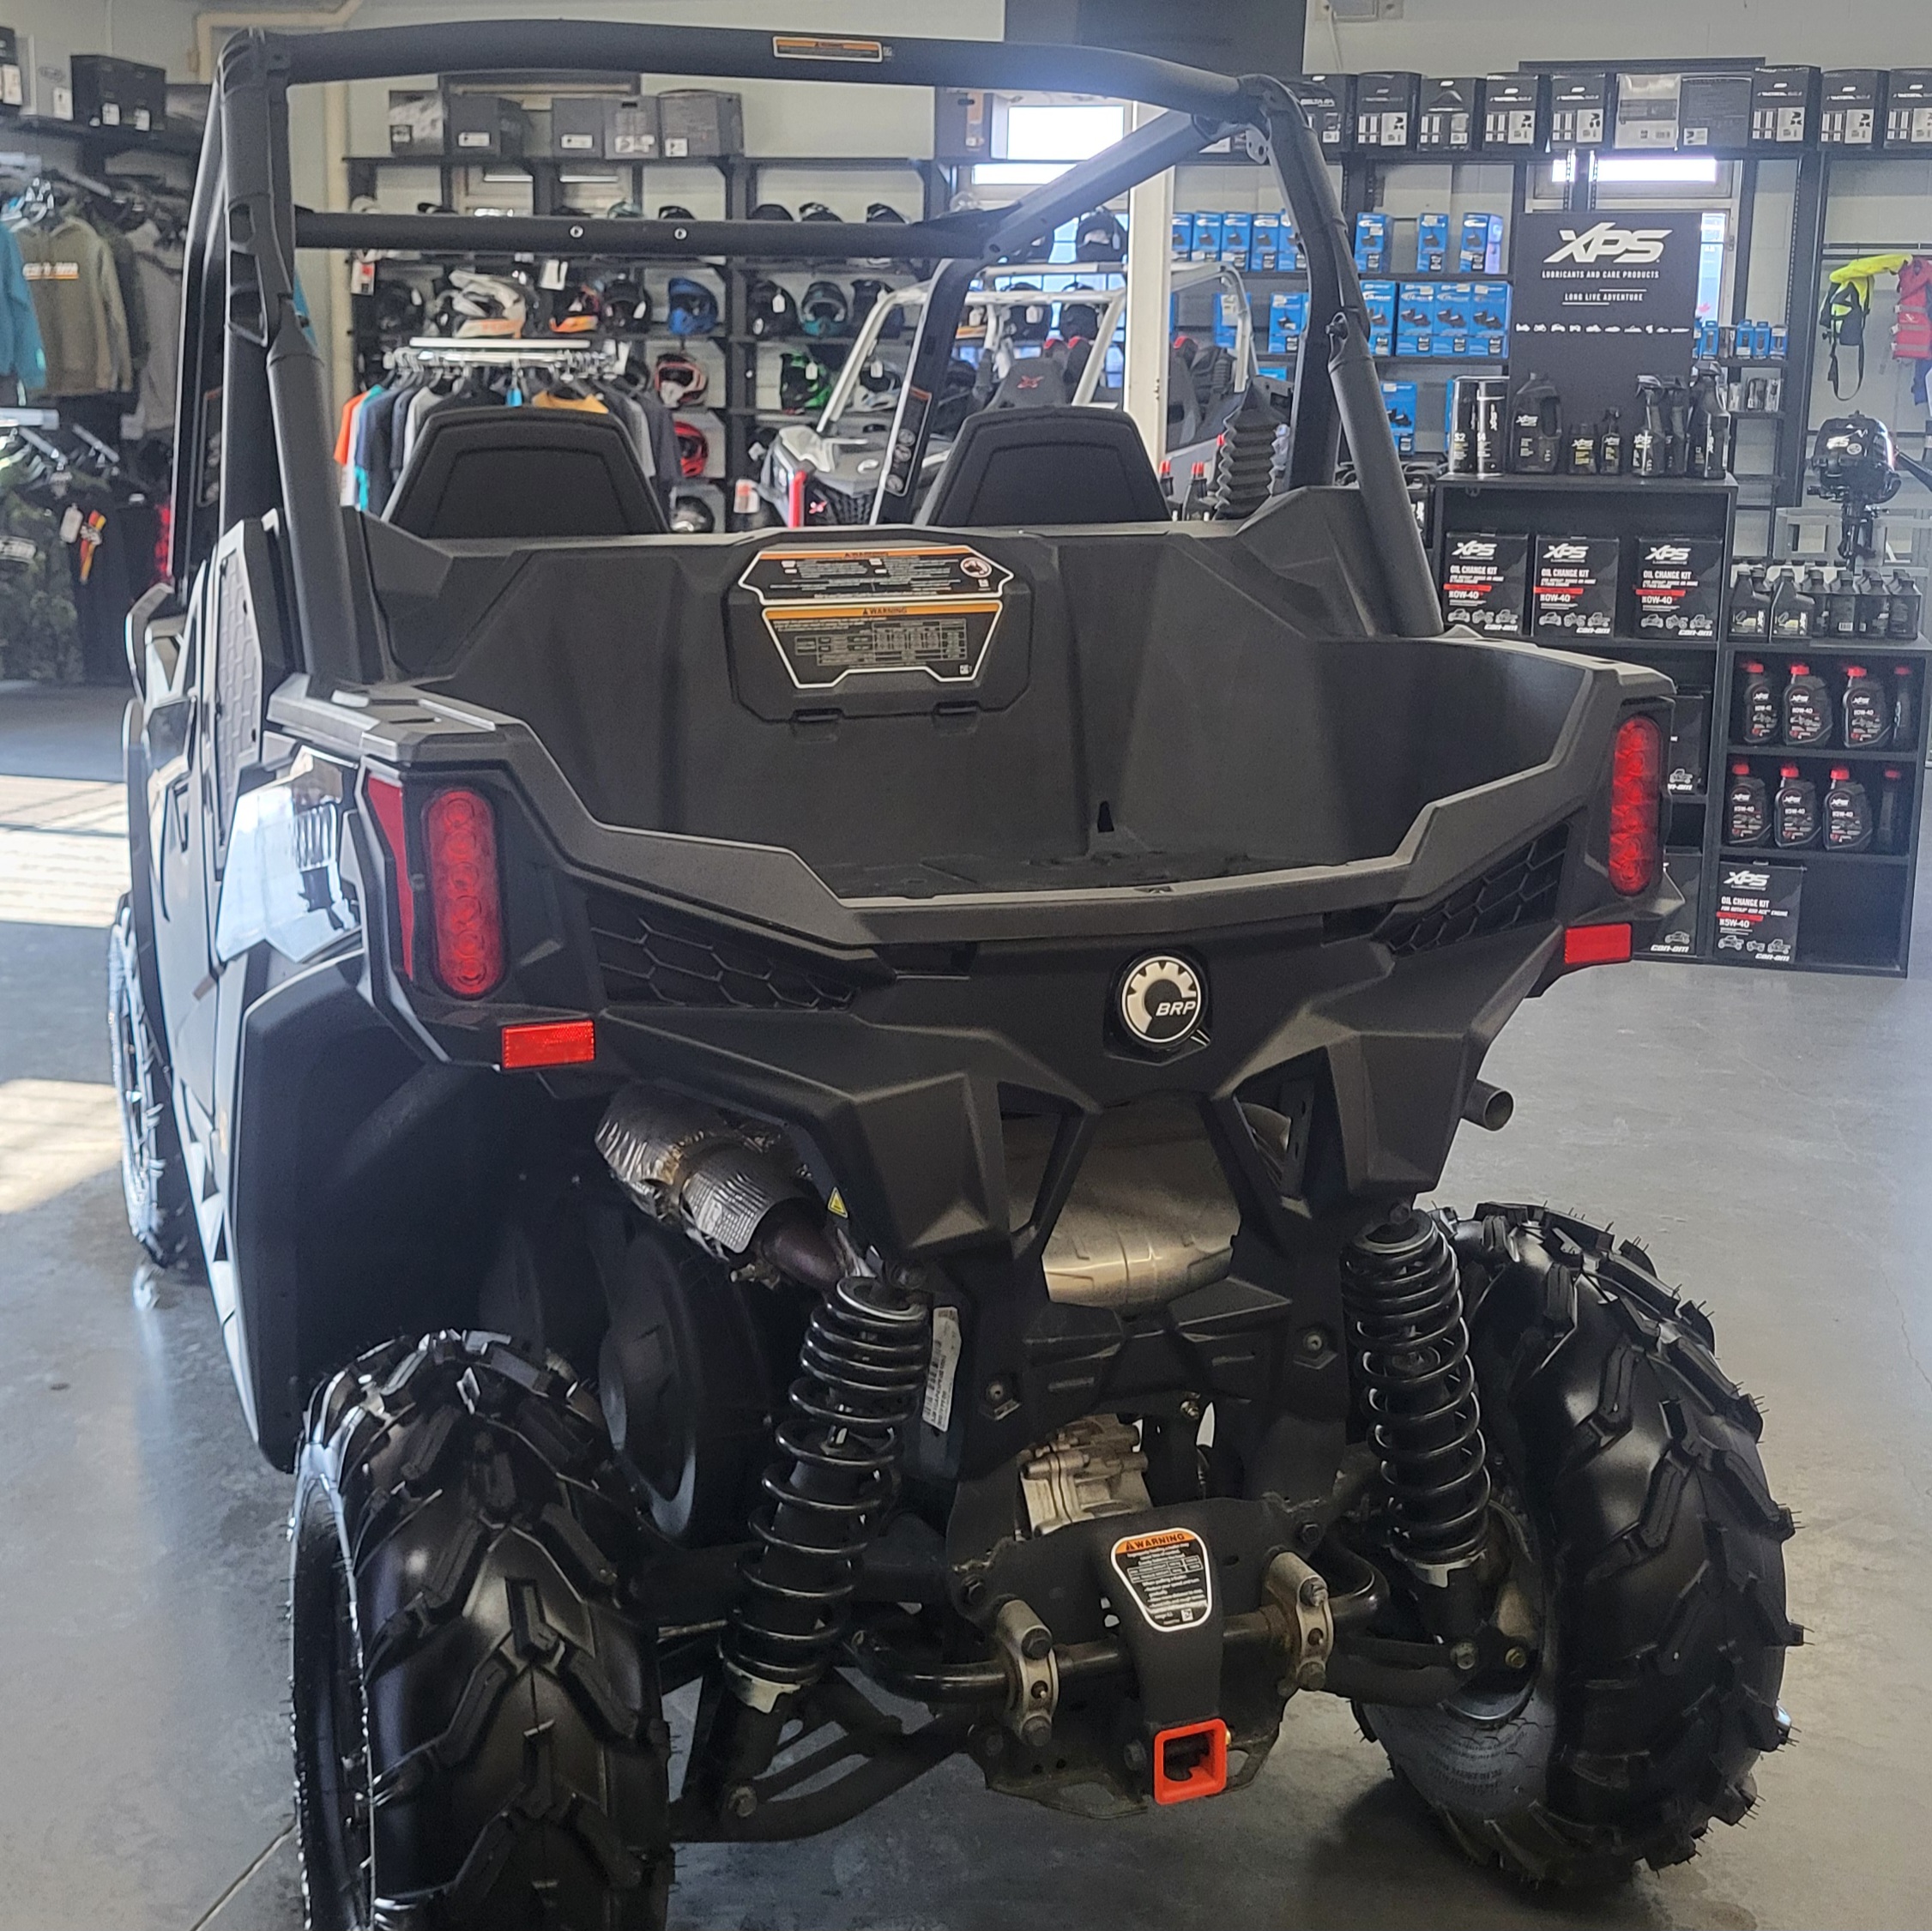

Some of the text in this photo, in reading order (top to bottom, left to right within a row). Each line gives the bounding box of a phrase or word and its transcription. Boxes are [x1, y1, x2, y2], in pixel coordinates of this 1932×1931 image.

[1543, 222, 1673, 262] XPS
[1542, 270, 1659, 279] LUBRICANTS AND CARE PRODUCTS
[1565, 293, 1643, 301] LONG LIVE ADVENTURE
[1452, 540, 1497, 555] XPS
[1543, 543, 1589, 558] XPS
[1645, 545, 1691, 560] XPS
[1450, 565, 1498, 575] OIL CHANGE KIT
[1542, 568, 1552, 576] OIL
[1553, 569, 1578, 577] CHANGE
[1643, 570, 1692, 580] OIL CHANGE KIT
[1724, 871, 1770, 886] XPS
[1721, 896, 1770, 908] OIL CHANGE KIT
[1156, 1001, 1196, 1017] BRP
[1134, 1533, 1185, 1548] WARNING
